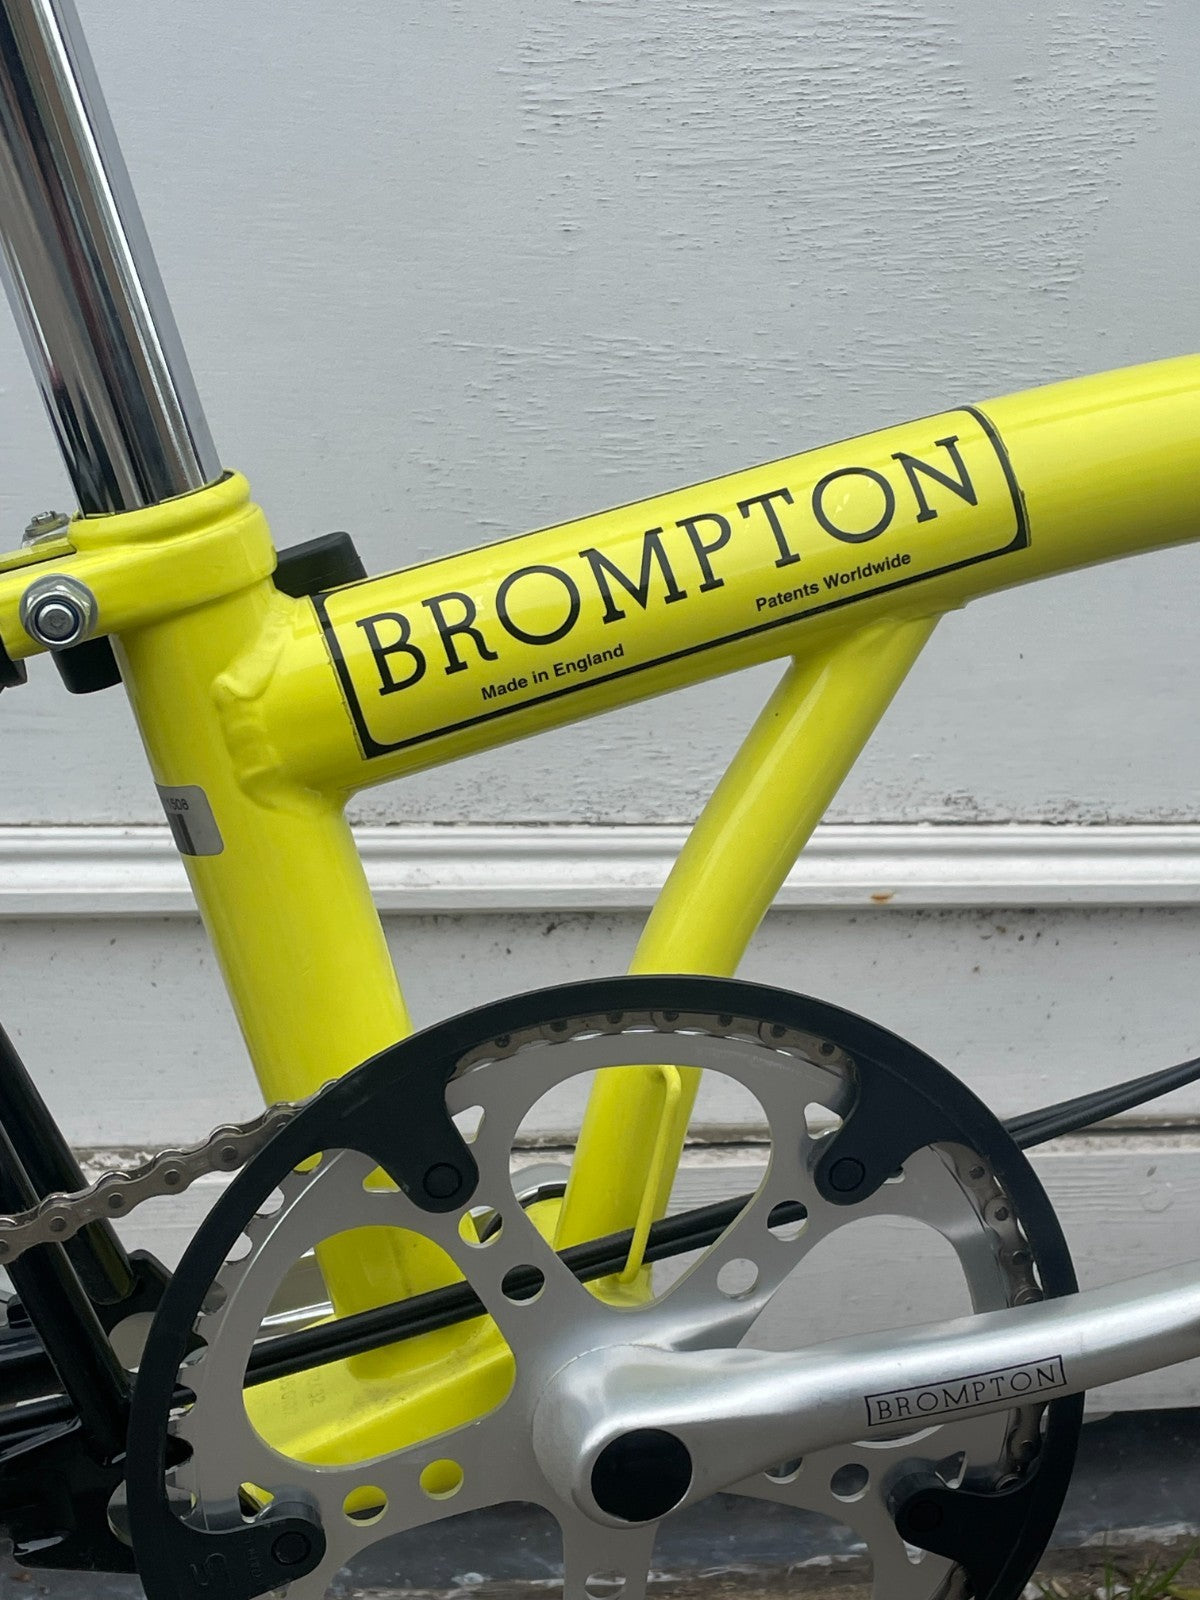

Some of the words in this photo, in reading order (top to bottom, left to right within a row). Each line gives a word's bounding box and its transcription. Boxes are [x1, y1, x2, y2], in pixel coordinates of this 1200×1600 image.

[355, 434, 979, 696] BROMPTON
[755, 581, 820, 611] Patents
[823, 553, 911, 589] Worldwide
[481, 677, 528, 700] Made
[532, 671, 550, 684] in
[553, 643, 624, 677] England
[876, 1364, 1056, 1420] BROMPTON
